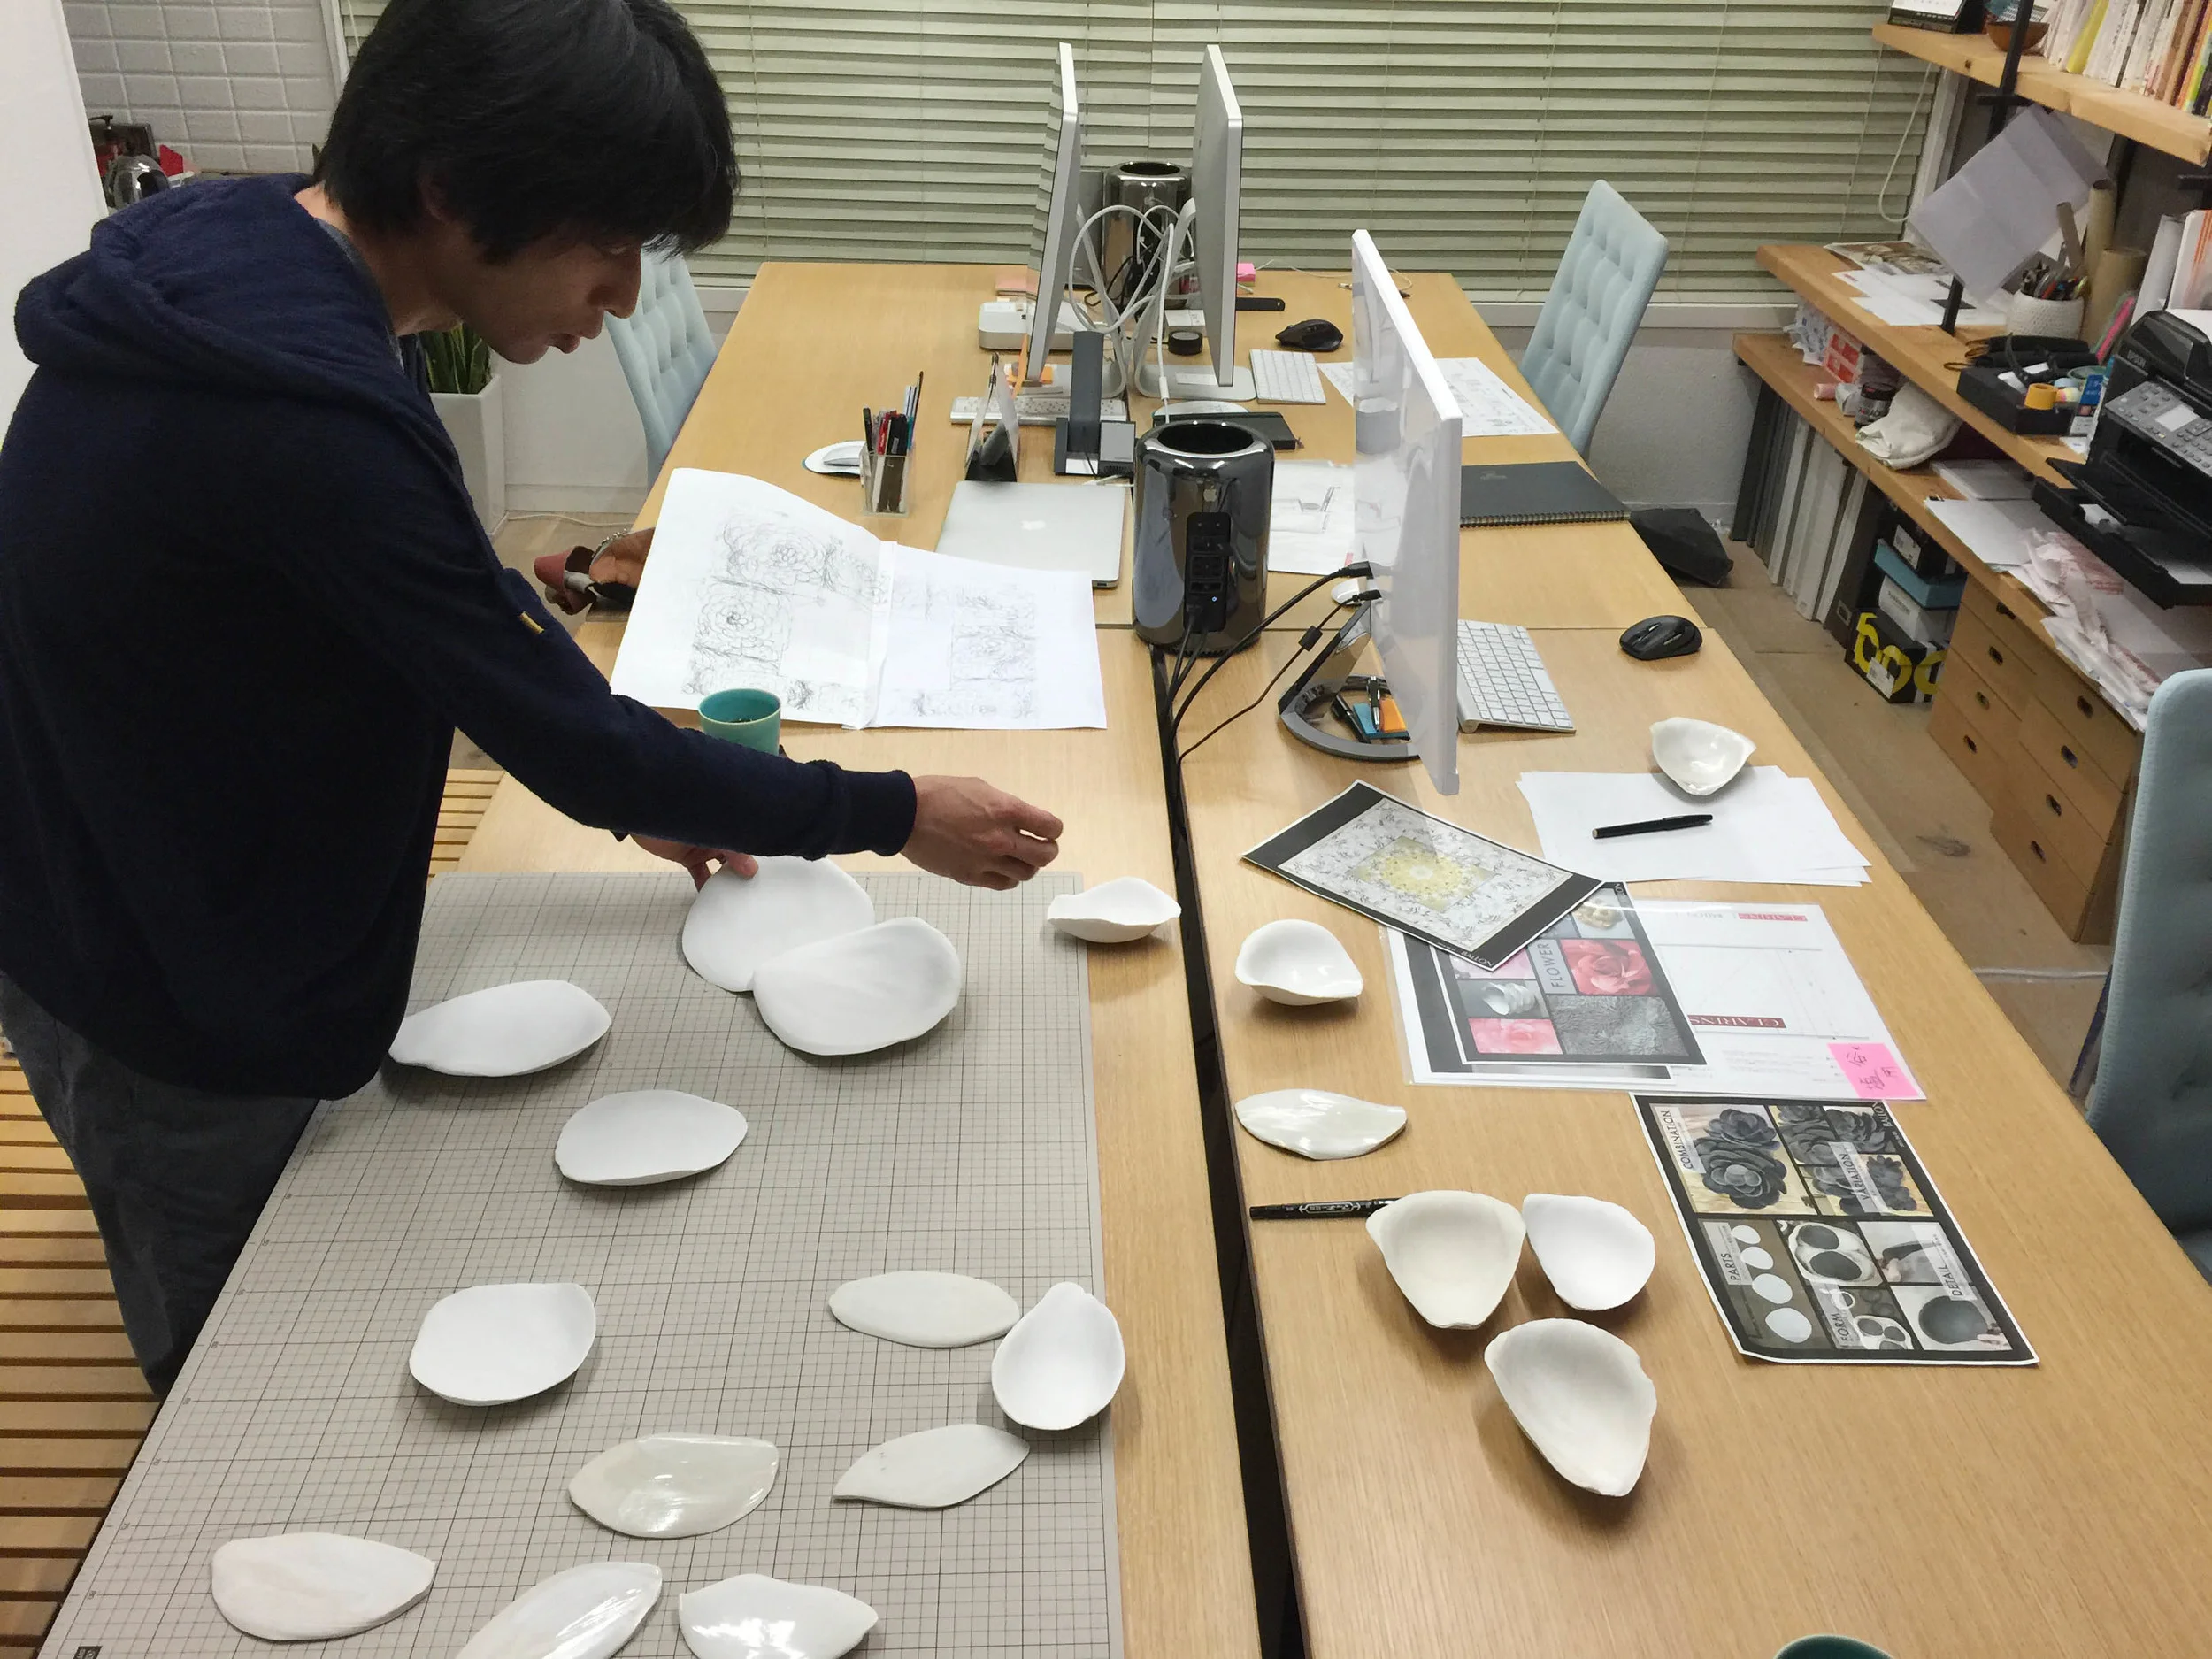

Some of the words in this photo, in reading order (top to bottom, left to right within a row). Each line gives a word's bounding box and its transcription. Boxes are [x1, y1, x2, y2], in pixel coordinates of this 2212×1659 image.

[1537, 943, 1565, 987] FLOWER
[1689, 1016, 1780, 1027] CLARINS
[1660, 1110, 1694, 1170] COMBINATION
[1839, 1153, 1871, 1201] VARIATION
[1720, 1253, 1741, 1280] PARTS
[1937, 1264, 1963, 1296] DETAIL
[1831, 1313, 1853, 1341] FORM
